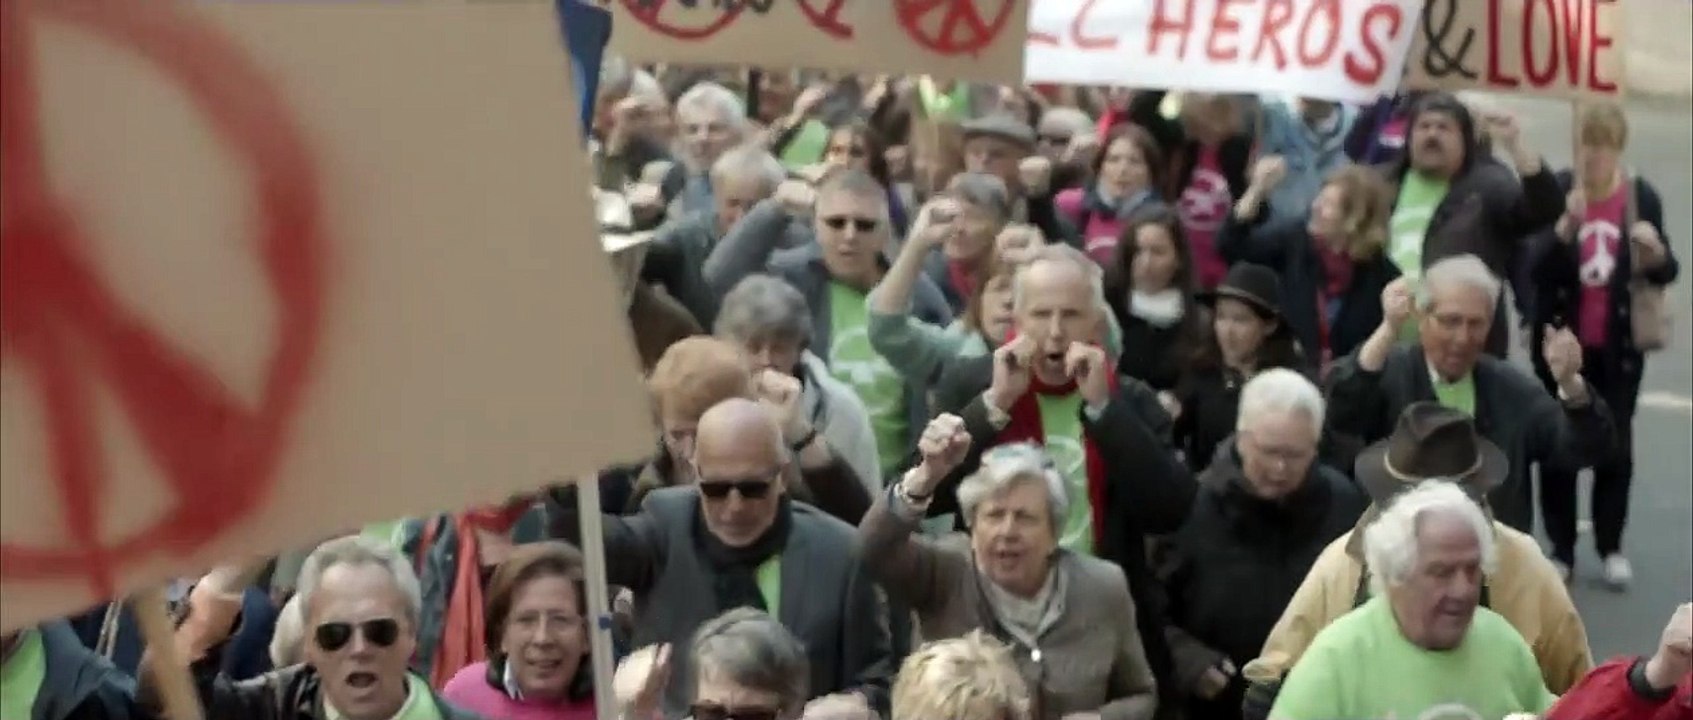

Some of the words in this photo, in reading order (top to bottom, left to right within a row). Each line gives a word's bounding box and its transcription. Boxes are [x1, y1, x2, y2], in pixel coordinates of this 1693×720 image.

[1147, 0, 1402, 85] HEROS
[1423, 0, 1478, 79] &
[1486, 0, 1618, 91] LOVE
